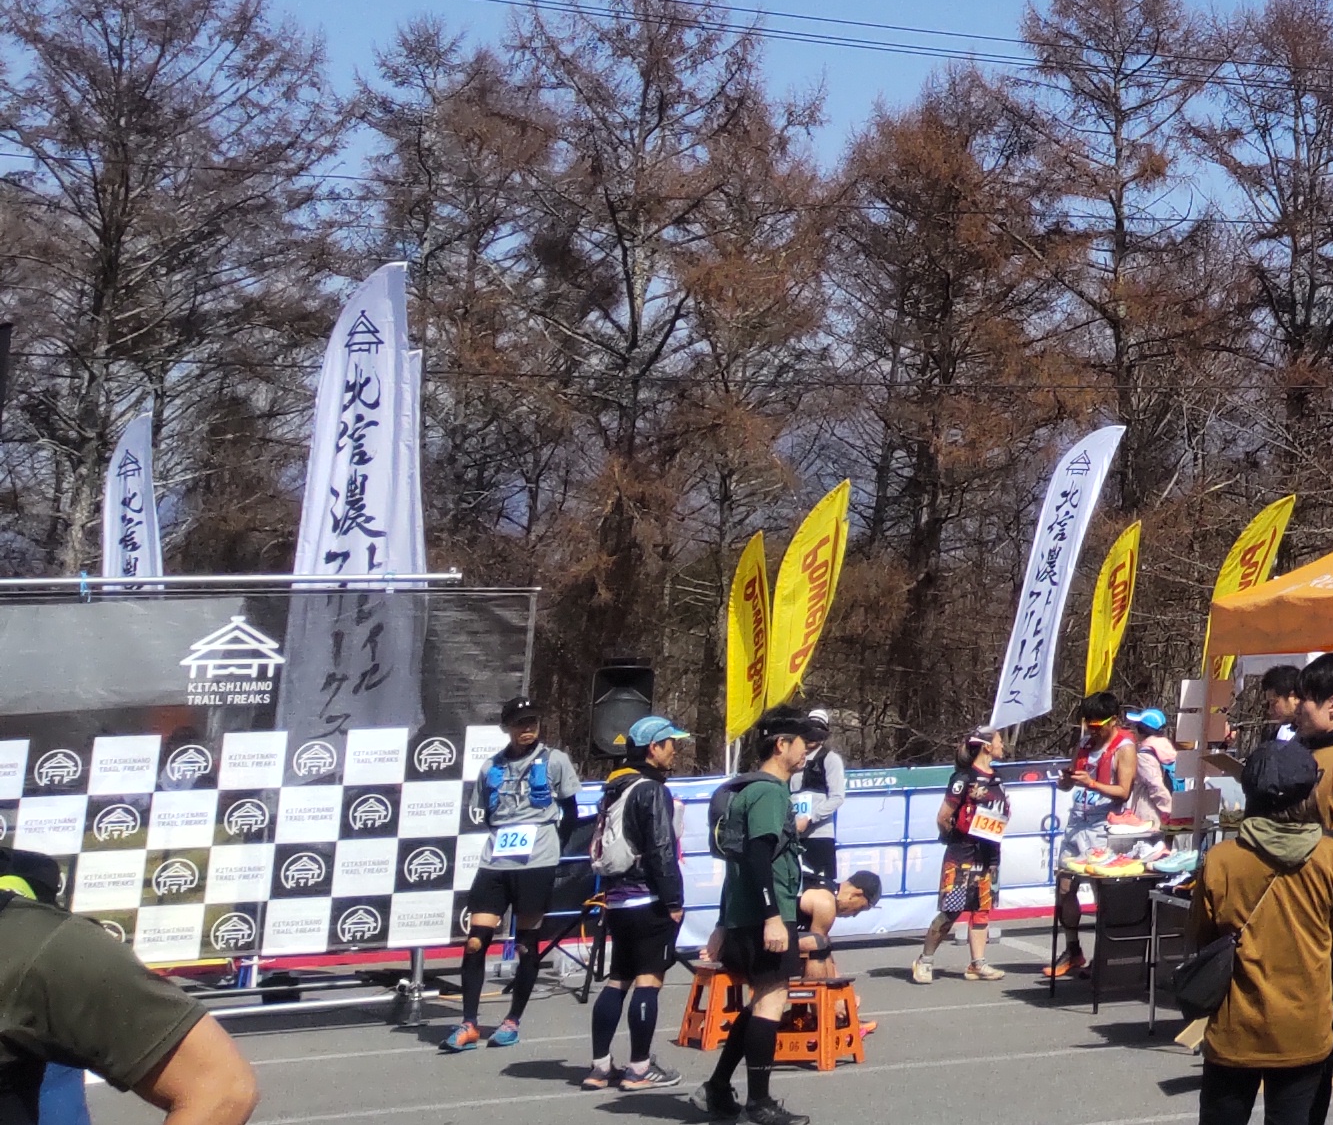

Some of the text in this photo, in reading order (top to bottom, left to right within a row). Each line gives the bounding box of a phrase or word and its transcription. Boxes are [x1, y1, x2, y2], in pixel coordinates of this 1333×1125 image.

[187, 681, 272, 693] KITASHINANO
[187, 694, 271, 706] TRAIL FREAKS
[975, 815, 1002, 834] 1345
[500, 832, 527, 848] 326
